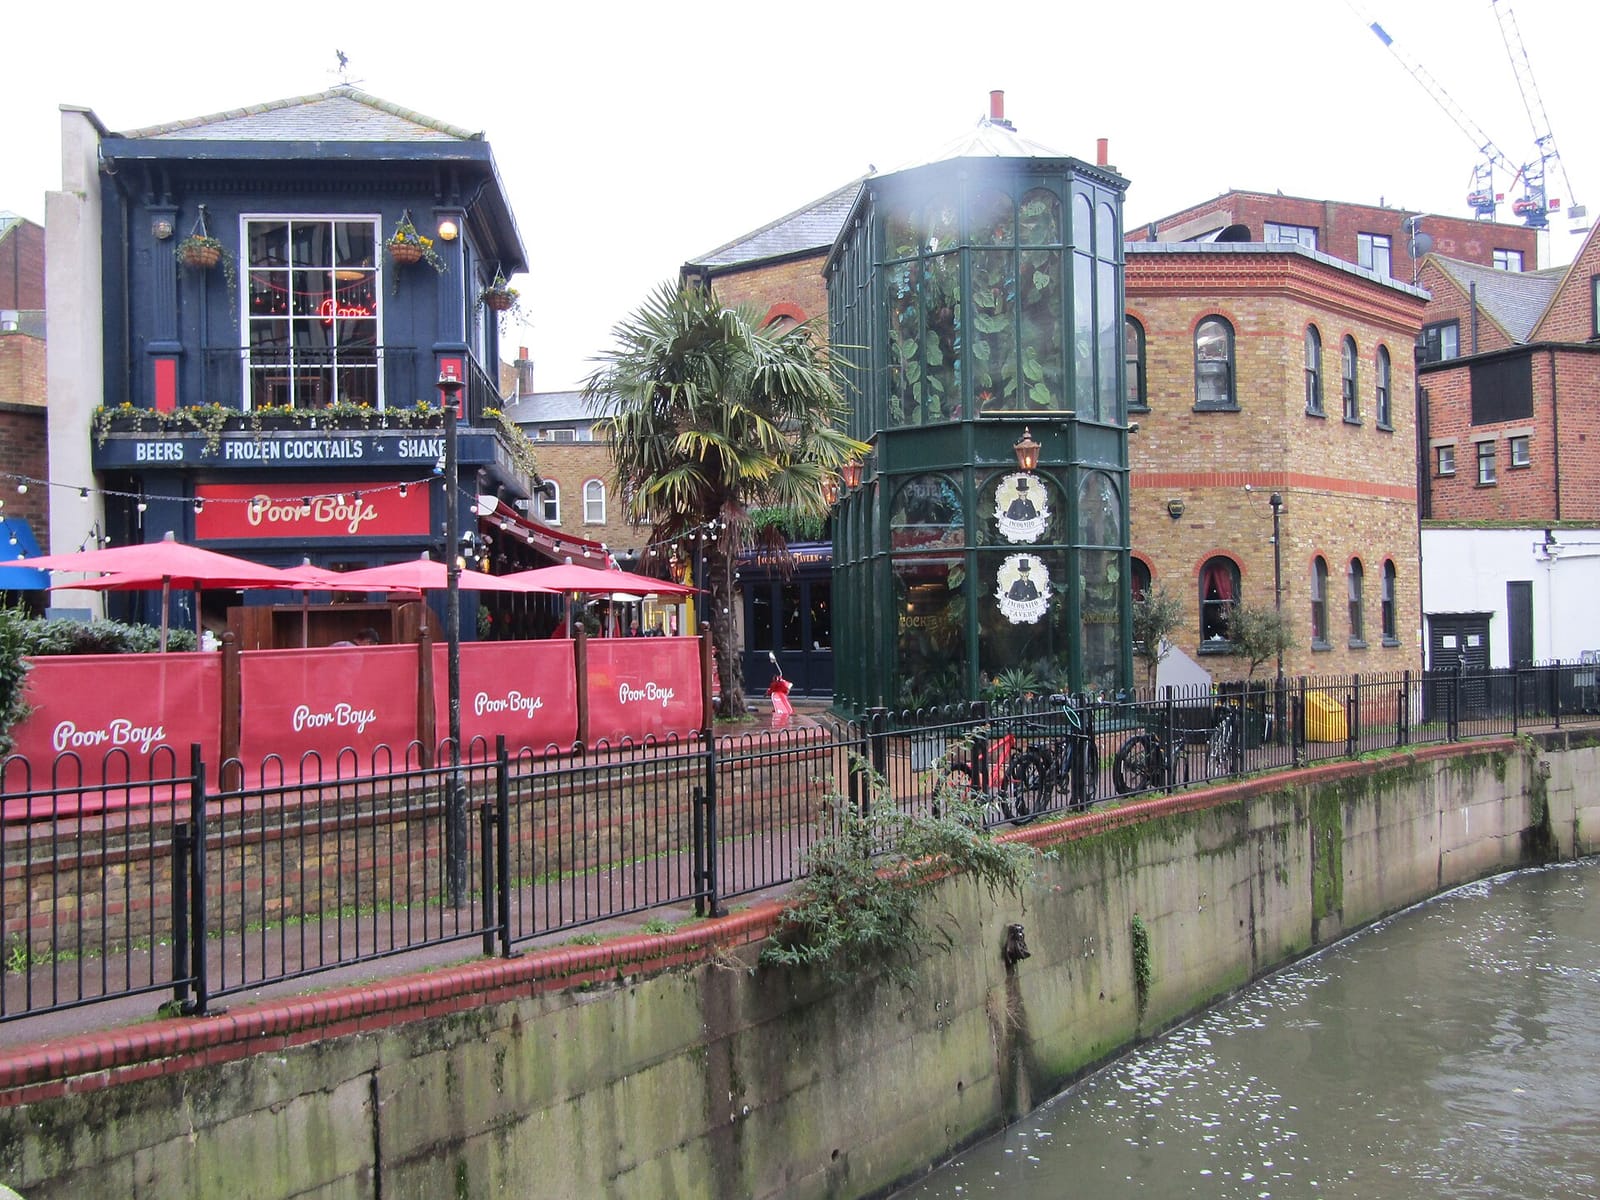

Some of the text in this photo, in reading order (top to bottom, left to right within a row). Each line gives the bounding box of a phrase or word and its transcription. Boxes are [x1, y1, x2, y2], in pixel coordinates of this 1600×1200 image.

[321, 298, 370, 323] Poor
[136, 442, 184, 461] BEERS
[225, 441, 280, 460] FROZEN
[284, 440, 363, 459] COCKTAILS
[247, 494, 378, 534] Poor Boys
[474, 690, 543, 719] Poor Boys
[619, 682, 675, 708] Poor Boys
[293, 703, 377, 734] Poor Boys
[53, 718, 166, 754] Poor Boys
